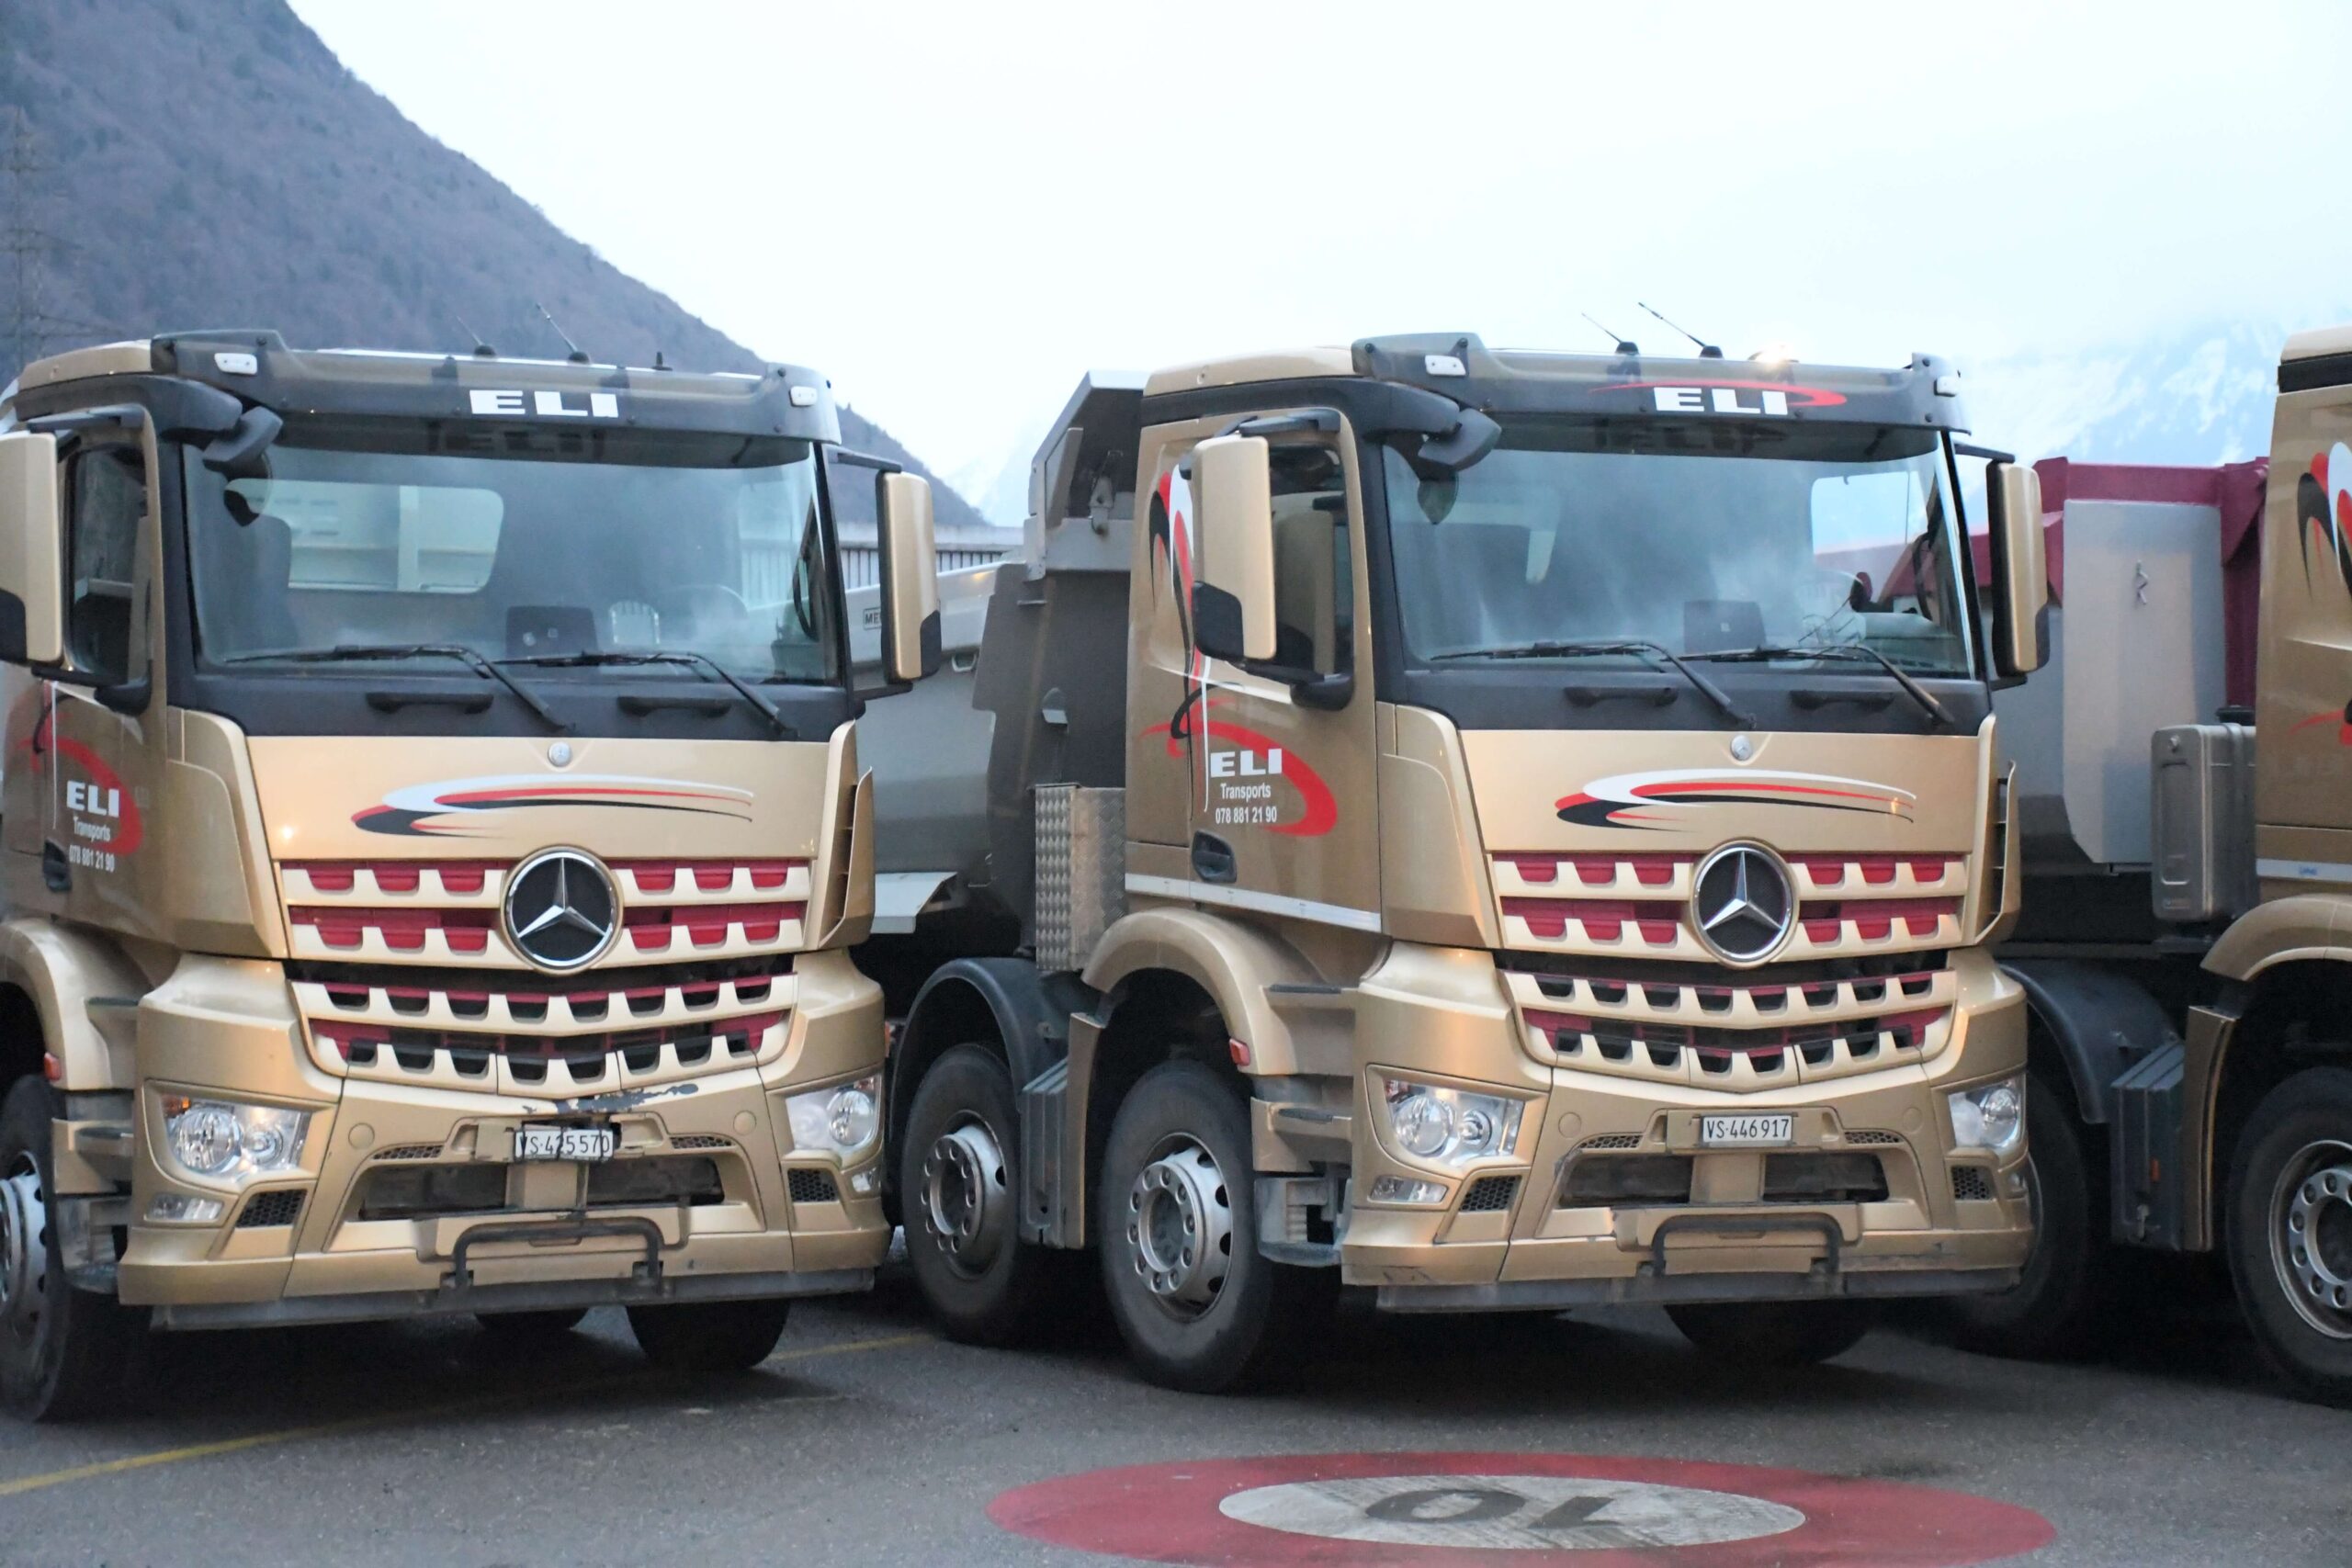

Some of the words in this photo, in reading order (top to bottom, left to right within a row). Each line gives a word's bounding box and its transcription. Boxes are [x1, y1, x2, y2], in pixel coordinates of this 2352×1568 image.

[469, 389, 618, 418] ELI
[1654, 387, 1788, 416] ELI
[1210, 748, 1283, 778] ELI
[66, 780, 119, 818] ELI
[1220, 783, 1272, 803] Transports
[74, 816, 110, 842] Transports
[1216, 807, 1231, 824] 078
[1233, 807, 1249, 824] 881
[1252, 807, 1263, 823] 21
[1266, 806, 1277, 823] 90
